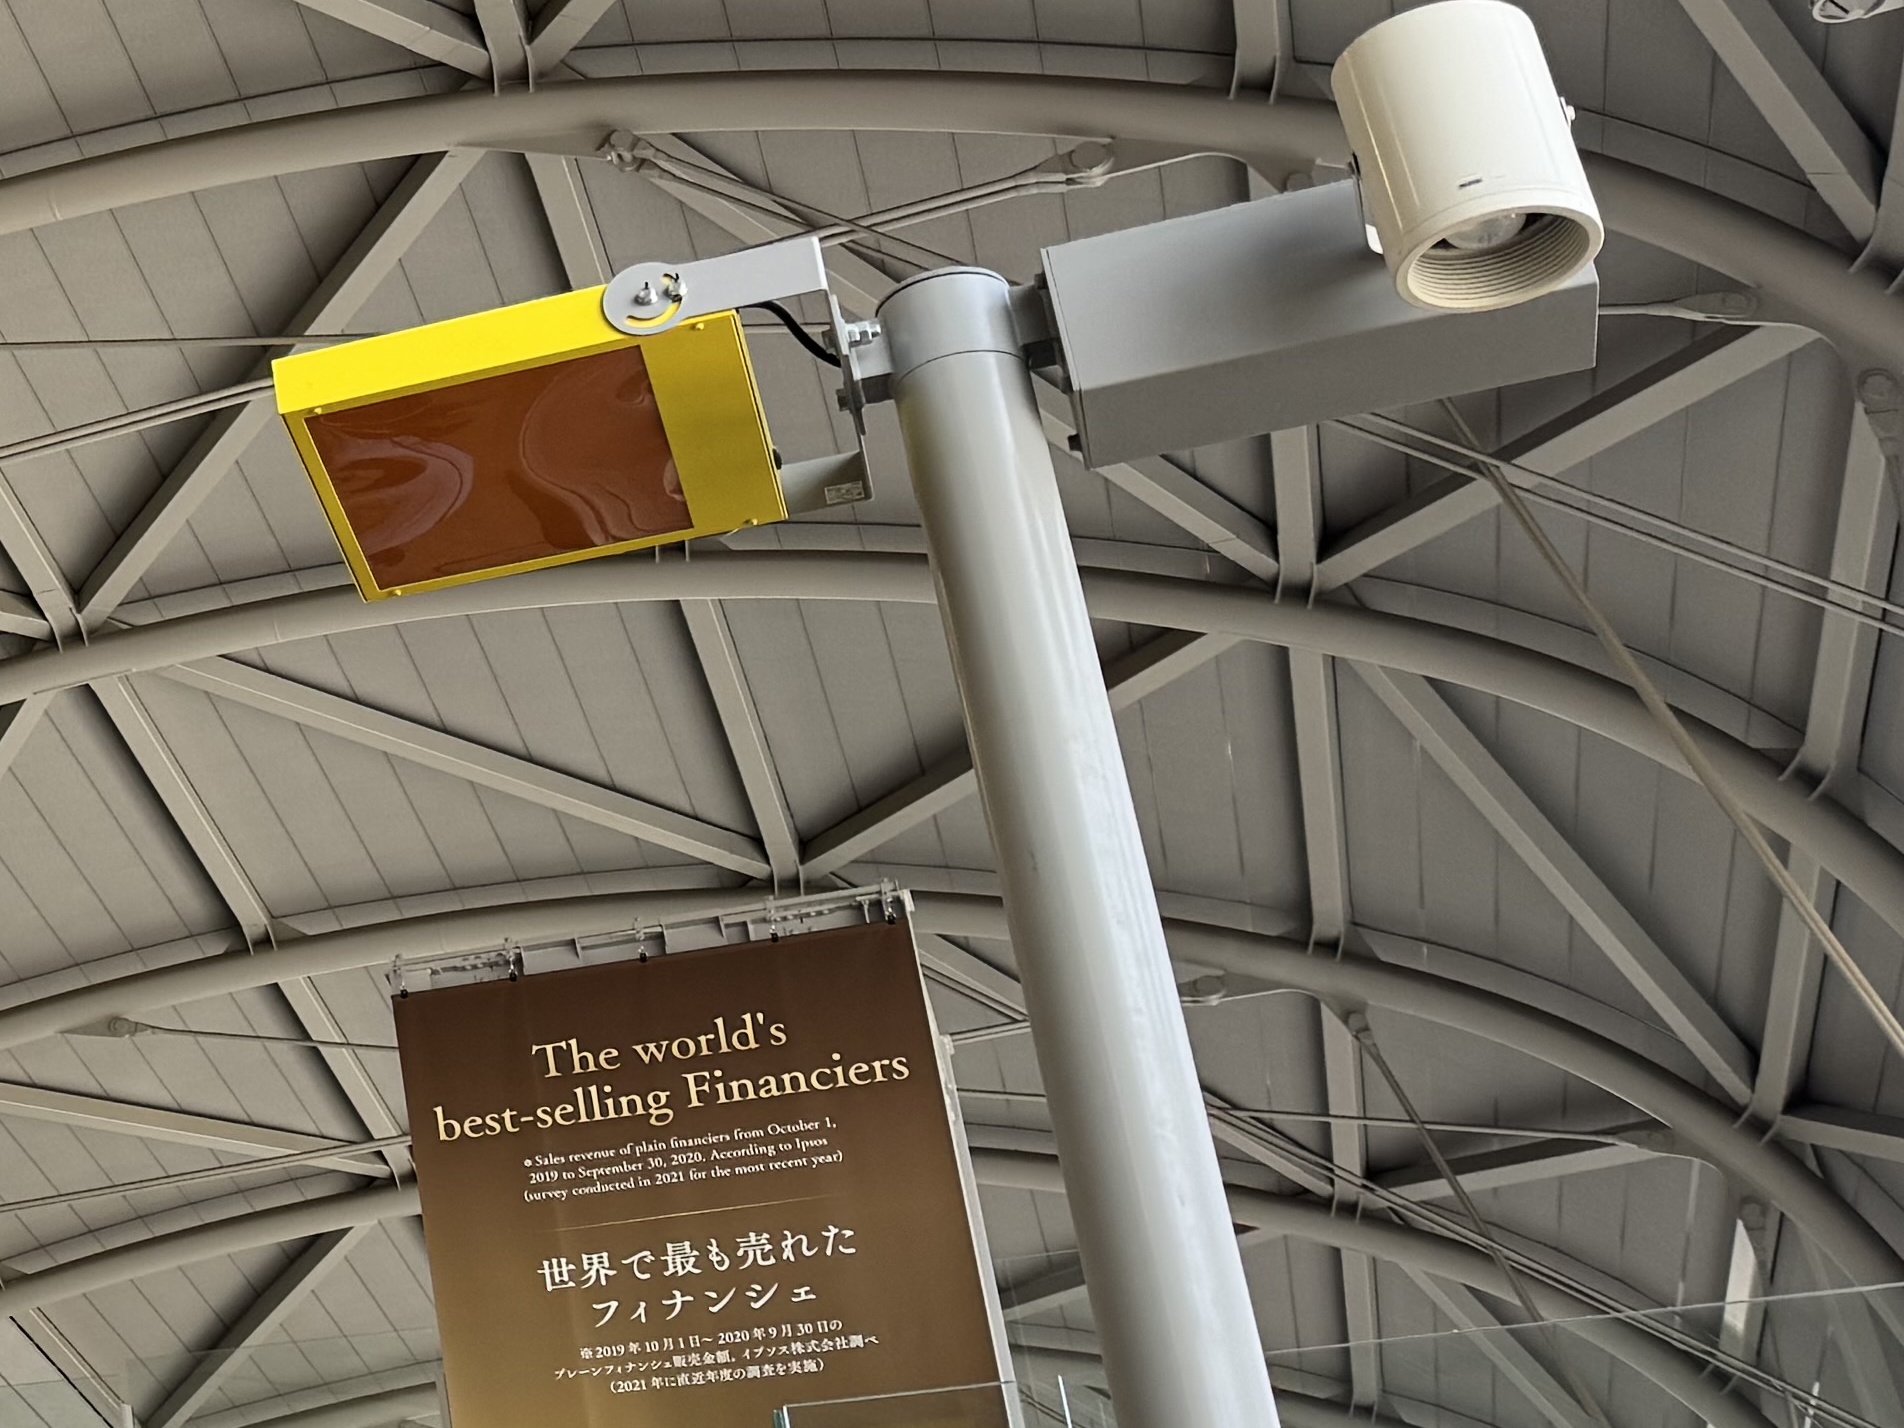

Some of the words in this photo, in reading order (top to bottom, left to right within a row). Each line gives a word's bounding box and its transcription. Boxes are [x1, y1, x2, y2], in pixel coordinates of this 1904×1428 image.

[532, 1037, 621, 1079] The
[633, 1012, 788, 1066] world's
[433, 1085, 675, 1142] best-selling
[682, 1052, 911, 1109] Financiers
[529, 1169, 559, 1185] 2019
[562, 1167, 576, 1181] to
[578, 1157, 644, 1183] September
[647, 1156, 668, 1170] 30,
[710, 1138, 777, 1162] According
[778, 1138, 793, 1152] to
[795, 1135, 829, 1154] Ipsos
[569, 1149, 616, 1163] revenue
[619, 1142, 634, 1157] of
[635, 1139, 667, 1161] plain
[670, 1132, 731, 1150] financiers
[733, 1127, 765, 1142] from
[767, 1119, 820, 1136] October
[523, 1185, 569, 1203] (survey
[571, 1177, 635, 1197] conducted
[637, 1172, 652, 1187] in
[655, 1170, 685, 1185] 2021
[689, 1167, 708, 1182] for
[711, 1163, 732, 1179] the
[734, 1160, 766, 1175] most
[769, 1154, 809, 1170] recent
[810, 1149, 844, 1170] year)
[537, 1224, 857, 1292] 世界で最も売れた
[592, 1283, 817, 1329] フィナンシェ
